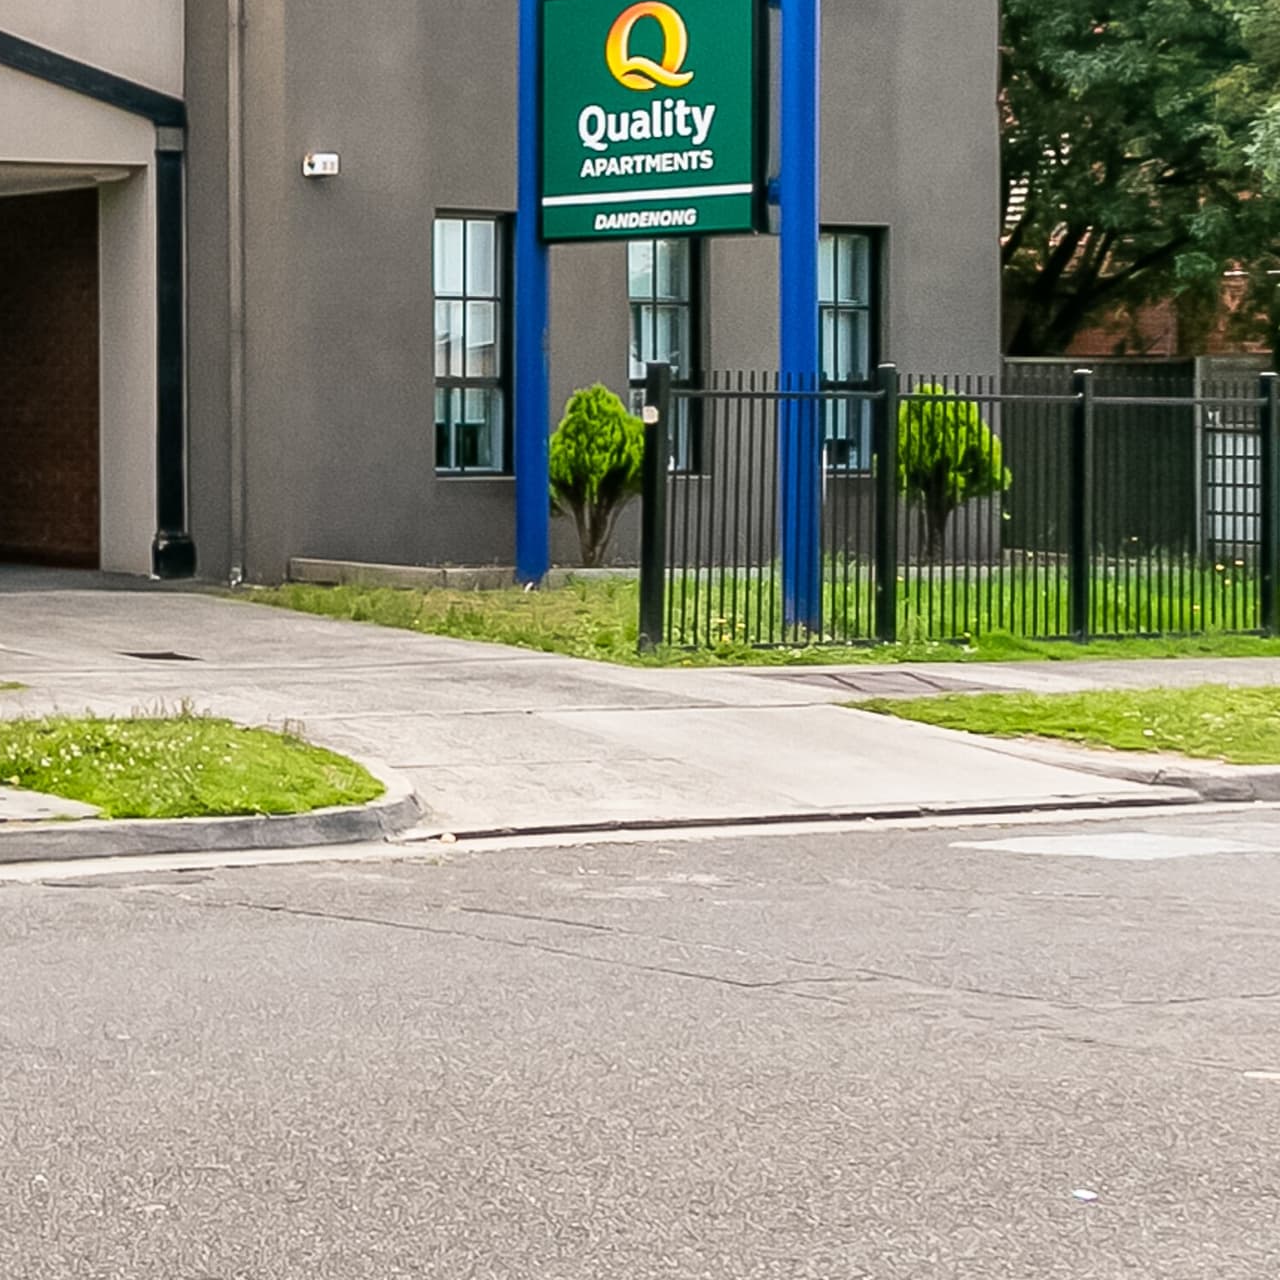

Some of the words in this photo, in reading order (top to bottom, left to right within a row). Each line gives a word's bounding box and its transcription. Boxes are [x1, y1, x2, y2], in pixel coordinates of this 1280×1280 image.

[605, 0, 695, 90] Q
[578, 98, 716, 151] Quality
[580, 149, 714, 178] APARTMENTS
[594, 208, 697, 231] DANDENONG
